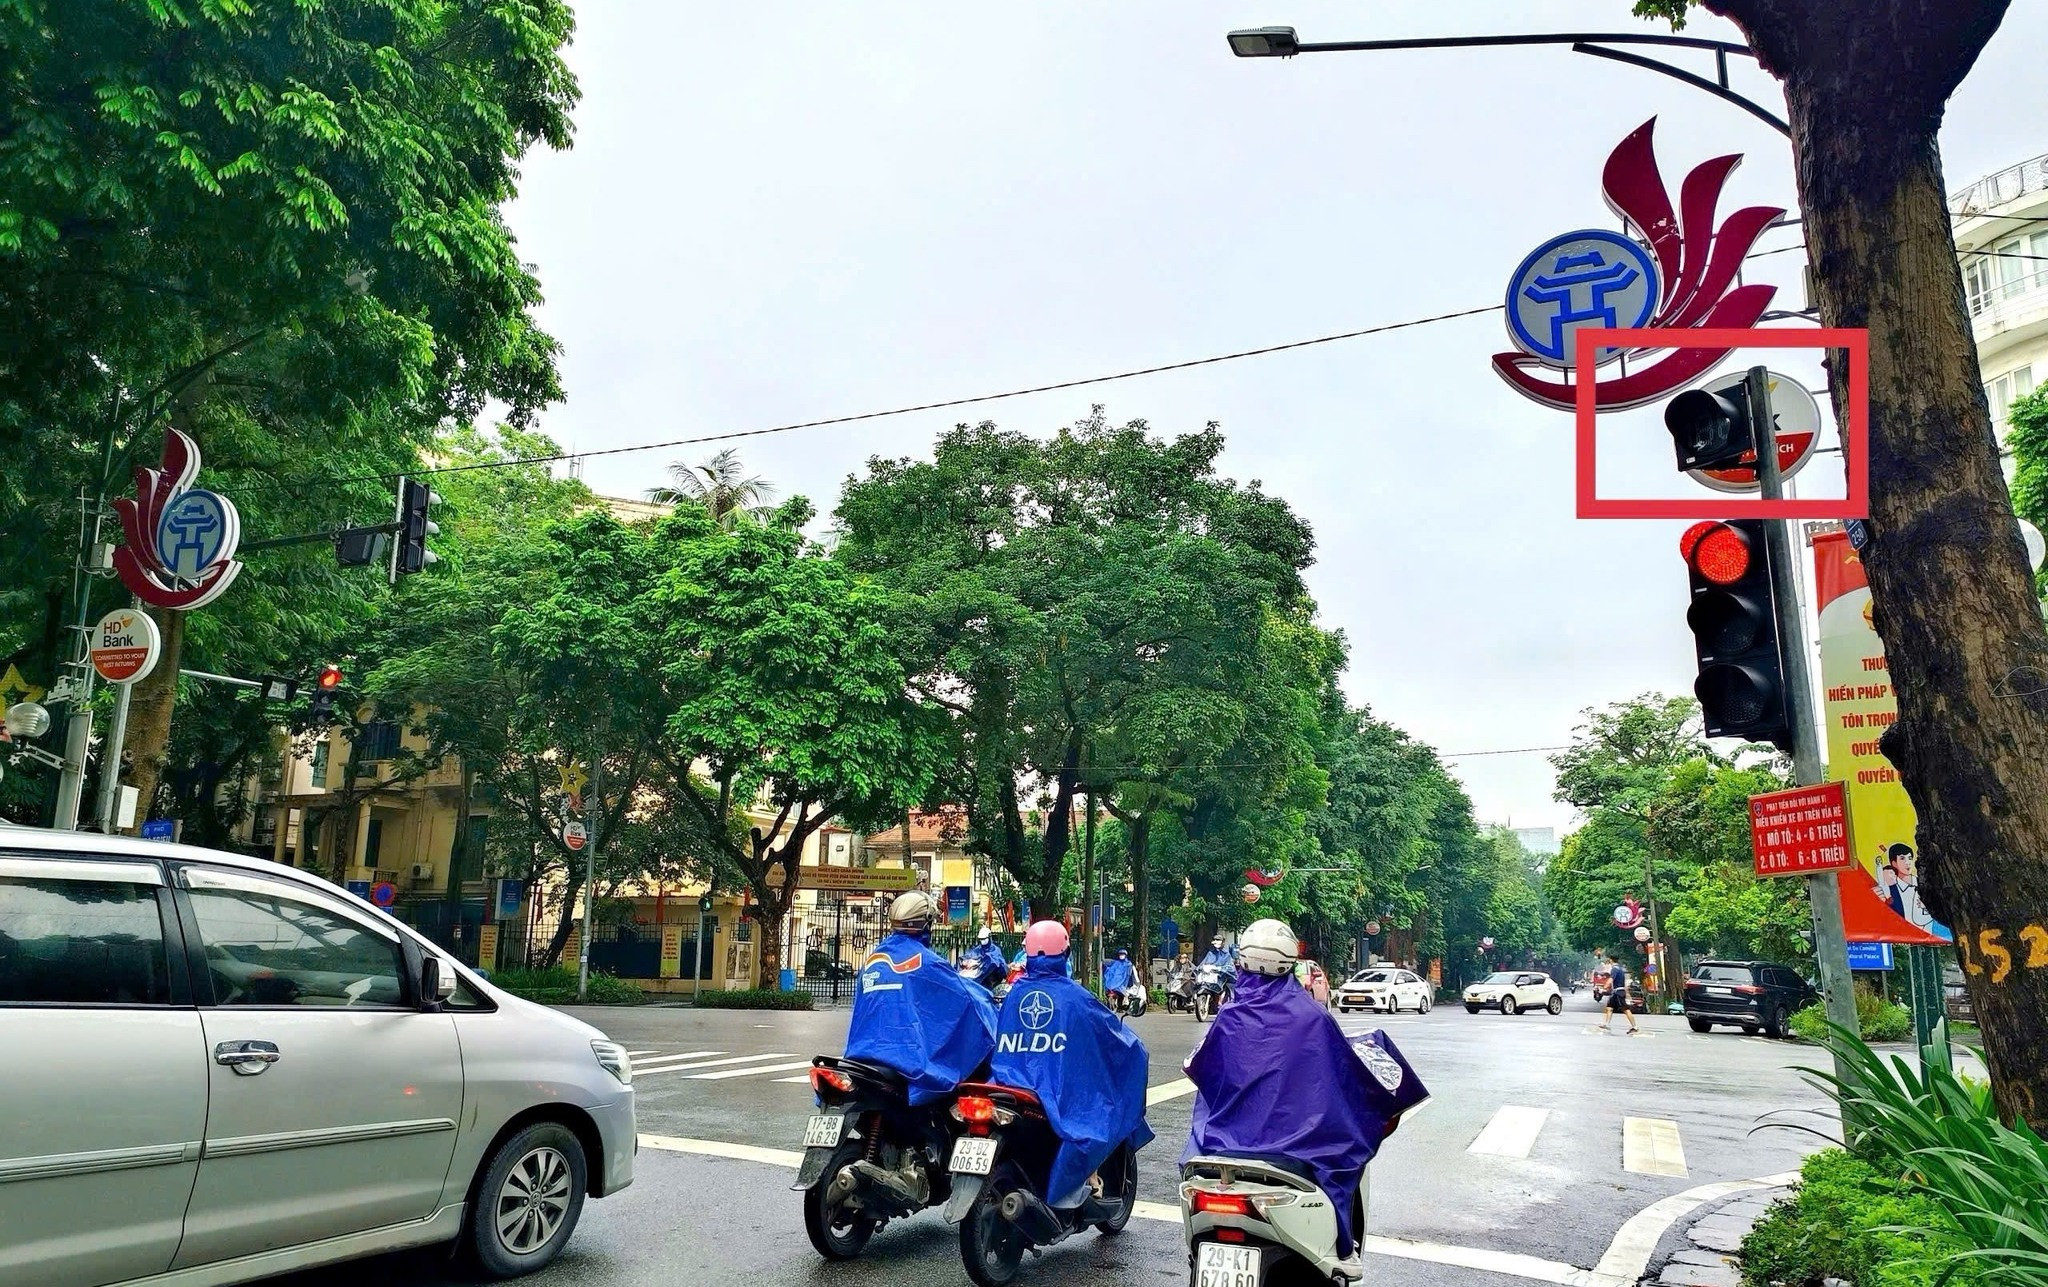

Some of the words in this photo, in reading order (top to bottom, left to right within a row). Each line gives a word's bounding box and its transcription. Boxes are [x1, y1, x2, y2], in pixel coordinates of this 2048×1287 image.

[103, 621, 122, 635] HD
[103, 634, 134, 648] Bank
[1828, 684, 1855, 702] HIẾN
[1857, 683, 1887, 700] PHÁP
[1841, 713, 1864, 729] TÔN
[1866, 712, 1898, 729] TRỌN
[1755, 814, 1769, 828] ĐIỀU
[1769, 811, 1788, 827] KHIỂN
[1788, 813, 1797, 824] XE
[1797, 812, 1804, 823] ĐI
[1805, 808, 1820, 821] TRÊN
[1833, 804, 1842, 817] HÈ
[1758, 834, 1766, 848] 1.
[1767, 829, 1780, 847] MÔ
[1781, 827, 1794, 845] TÔ:
[1796, 829, 1802, 843] 4
[1809, 827, 1815, 841] 6
[1817, 821, 1843, 842] TRIỆU
[1760, 855, 1768, 869] 2.
[1769, 851, 1775, 868] Ô
[1776, 850, 1789, 867] TÔ:
[1798, 851, 1804, 866] 6
[1811, 849, 1817, 864] 8
[1820, 844, 1845, 865] TRIỆU
[997, 1032, 1068, 1053] NLDC
[805, 1131, 838, 1145] 146.29
[959, 1140, 990, 1156] 29-B2
[951, 1155, 989, 1172] 006.59
[1207, 1247, 1250, 1271] 29-K1
